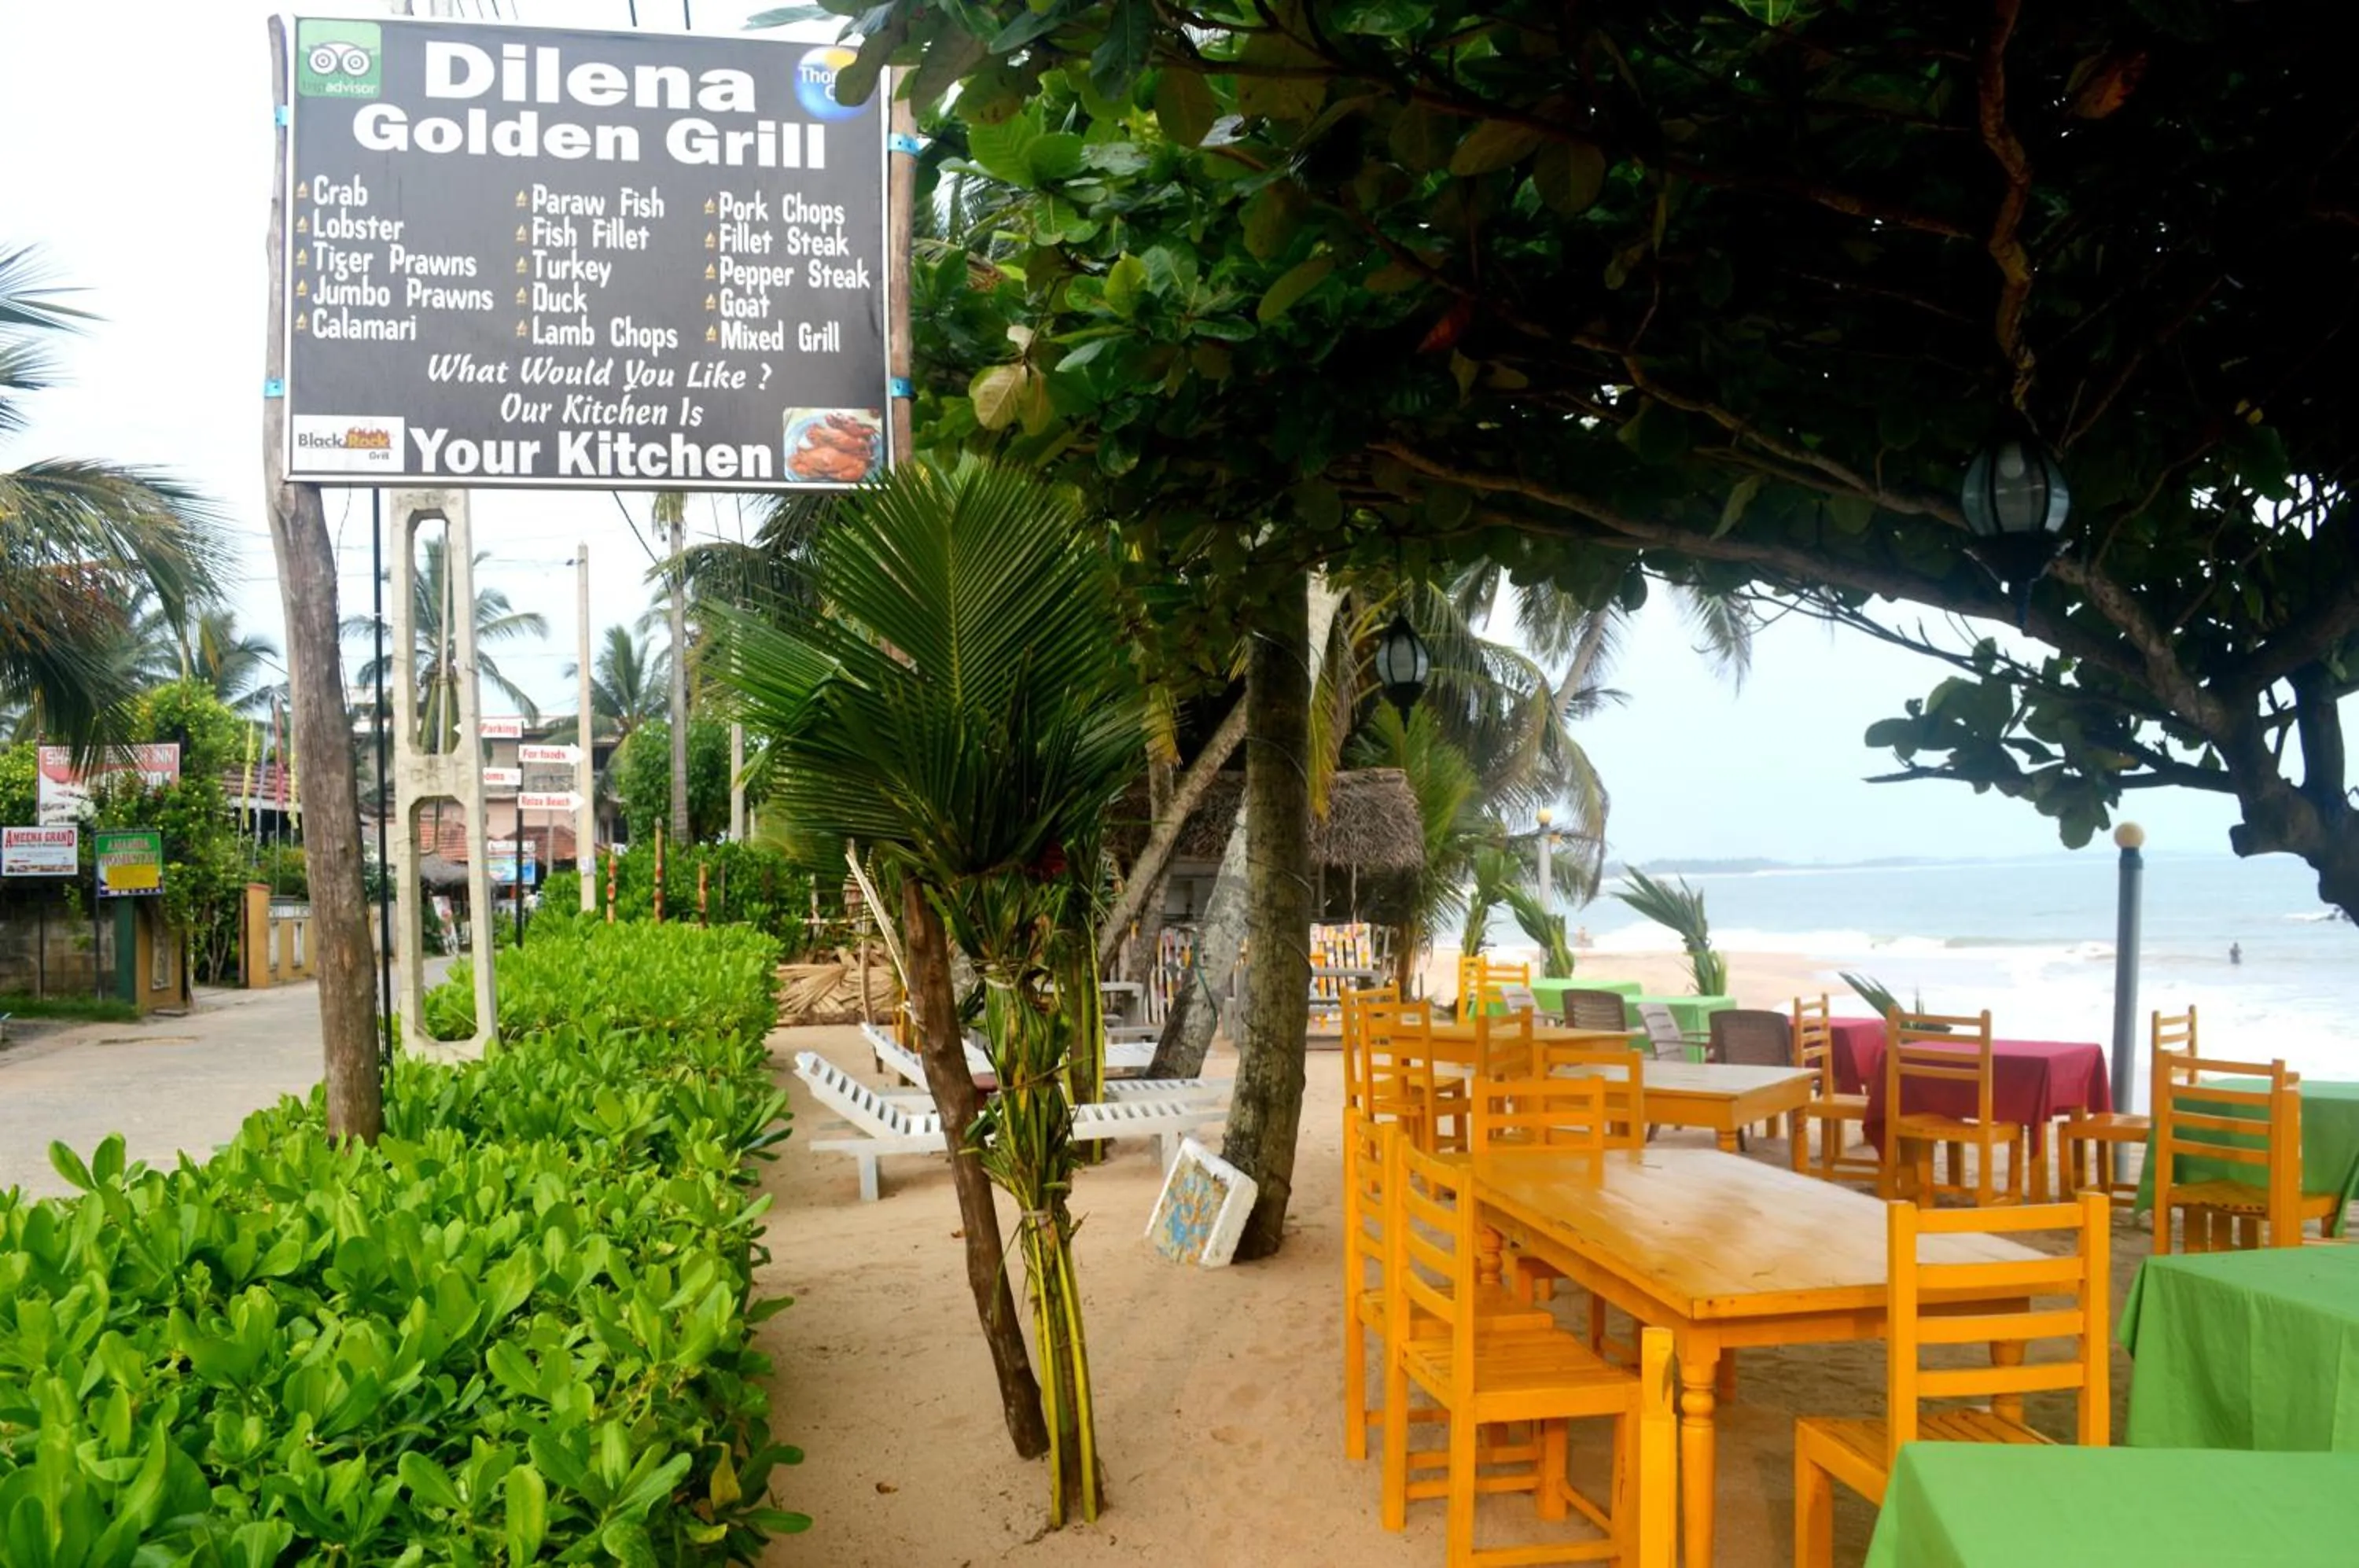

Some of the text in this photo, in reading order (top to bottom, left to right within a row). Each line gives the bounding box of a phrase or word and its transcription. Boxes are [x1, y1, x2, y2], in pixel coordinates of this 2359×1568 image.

[425, 40, 755, 112] Dilena
[352, 103, 825, 169] Golden Grill
[313, 174, 368, 207] Crab
[532, 183, 664, 219] Paraw Fish
[313, 207, 404, 241] Lobster
[719, 190, 845, 235] Pork Chops
[532, 215, 650, 250] Fish Fillet
[719, 222, 850, 256] Fillet Steak
[312, 241, 477, 282] Tiger Prawns
[532, 248, 612, 289] Turkey
[719, 255, 870, 296] Pepper Steak
[312, 274, 494, 311] Jumbo Prawns
[532, 281, 588, 313] Duck
[719, 291, 771, 318] Goat
[312, 306, 416, 340] Calamari
[532, 314, 679, 358] Lamb Chops
[720, 319, 840, 352] Mixed Grill
[428, 353, 772, 392] What Would You Like ?
[501, 392, 704, 427] Our Kitchen Is
[299, 432, 388, 448] Black Rock
[409, 427, 772, 478] Your Kitchen
[480, 723, 518, 735] Parking
[523, 749, 537, 759] For
[483, 772, 504, 782] oms
[546, 796, 570, 806] Beach
[45, 830, 74, 847] GRAND
